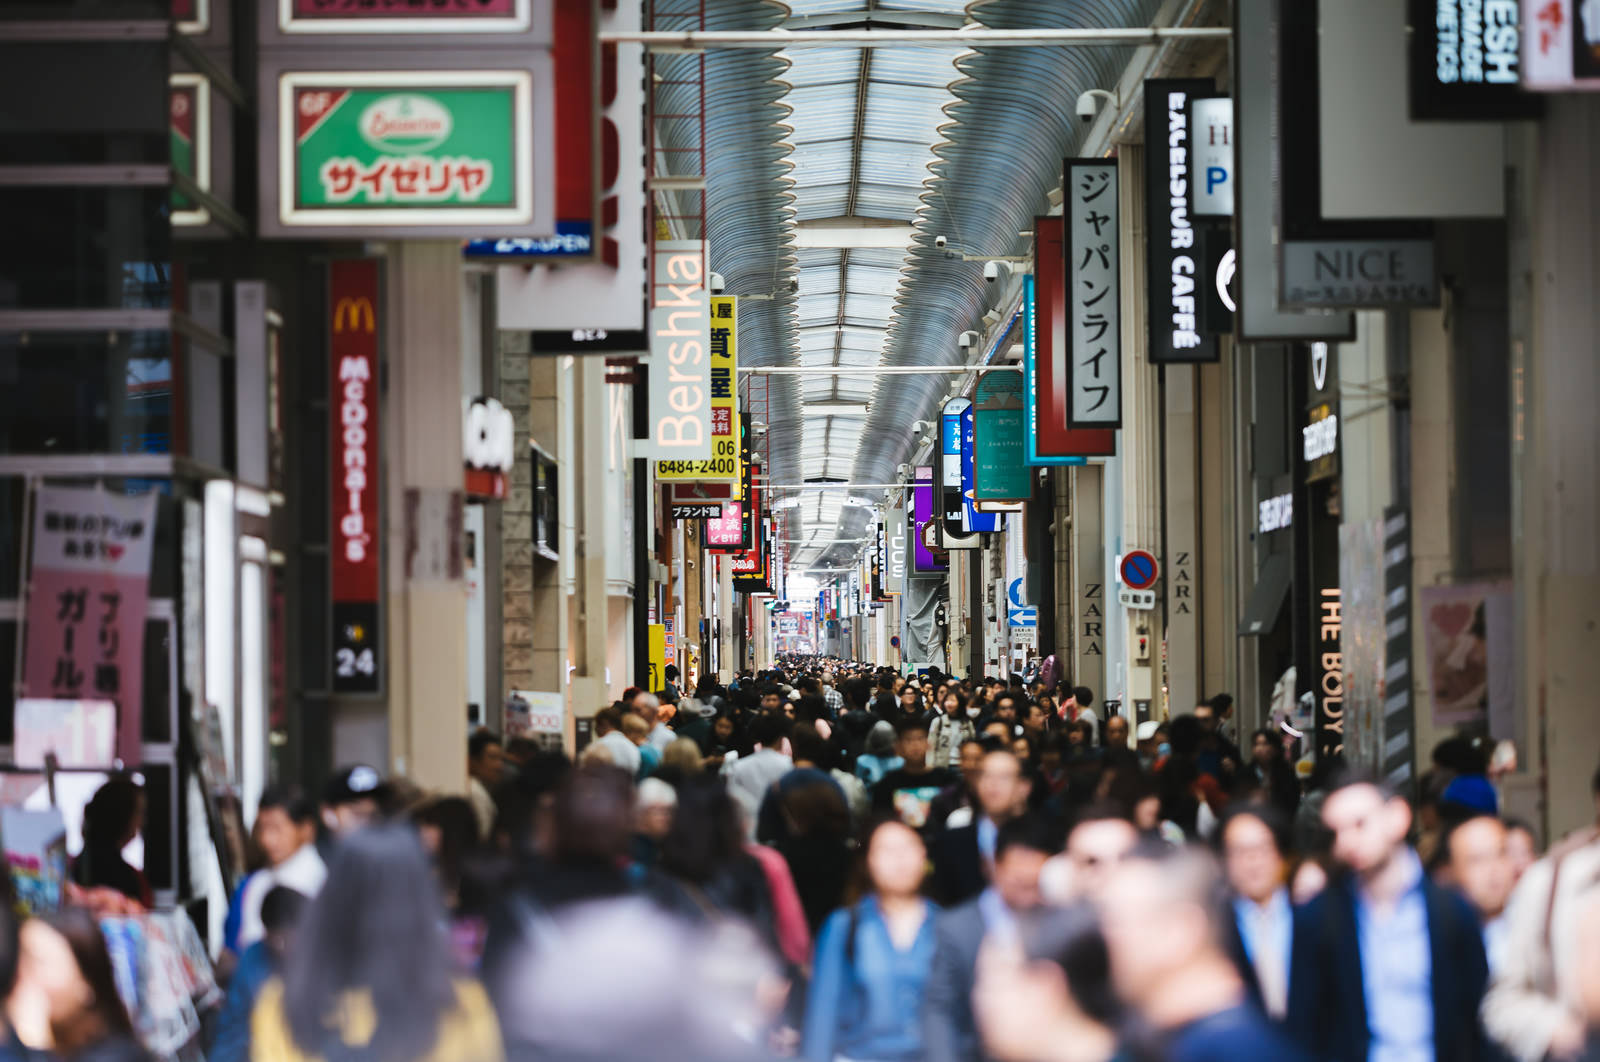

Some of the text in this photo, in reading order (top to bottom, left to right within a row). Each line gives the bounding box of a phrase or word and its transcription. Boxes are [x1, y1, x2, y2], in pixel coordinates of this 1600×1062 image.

[325, 160, 487, 196] サイゼリヤ
[1206, 166, 1228, 195] P
[1314, 250, 1406, 282] NICE
[1079, 171, 1111, 414] ジャパンライフ
[1171, 255, 1200, 349] CAFFÉ
[656, 252, 703, 447] Bershka
[338, 355, 371, 563] McDonald's
[658, 458, 735, 474] 6484-2400
[717, 440, 735, 456] 06
[671, 506, 720, 518] ブランド館
[1174, 551, 1192, 614] ZARA
[1083, 583, 1103, 655] ZARA
[336, 648, 376, 677] 24
[1320, 652, 1343, 735] BODY
